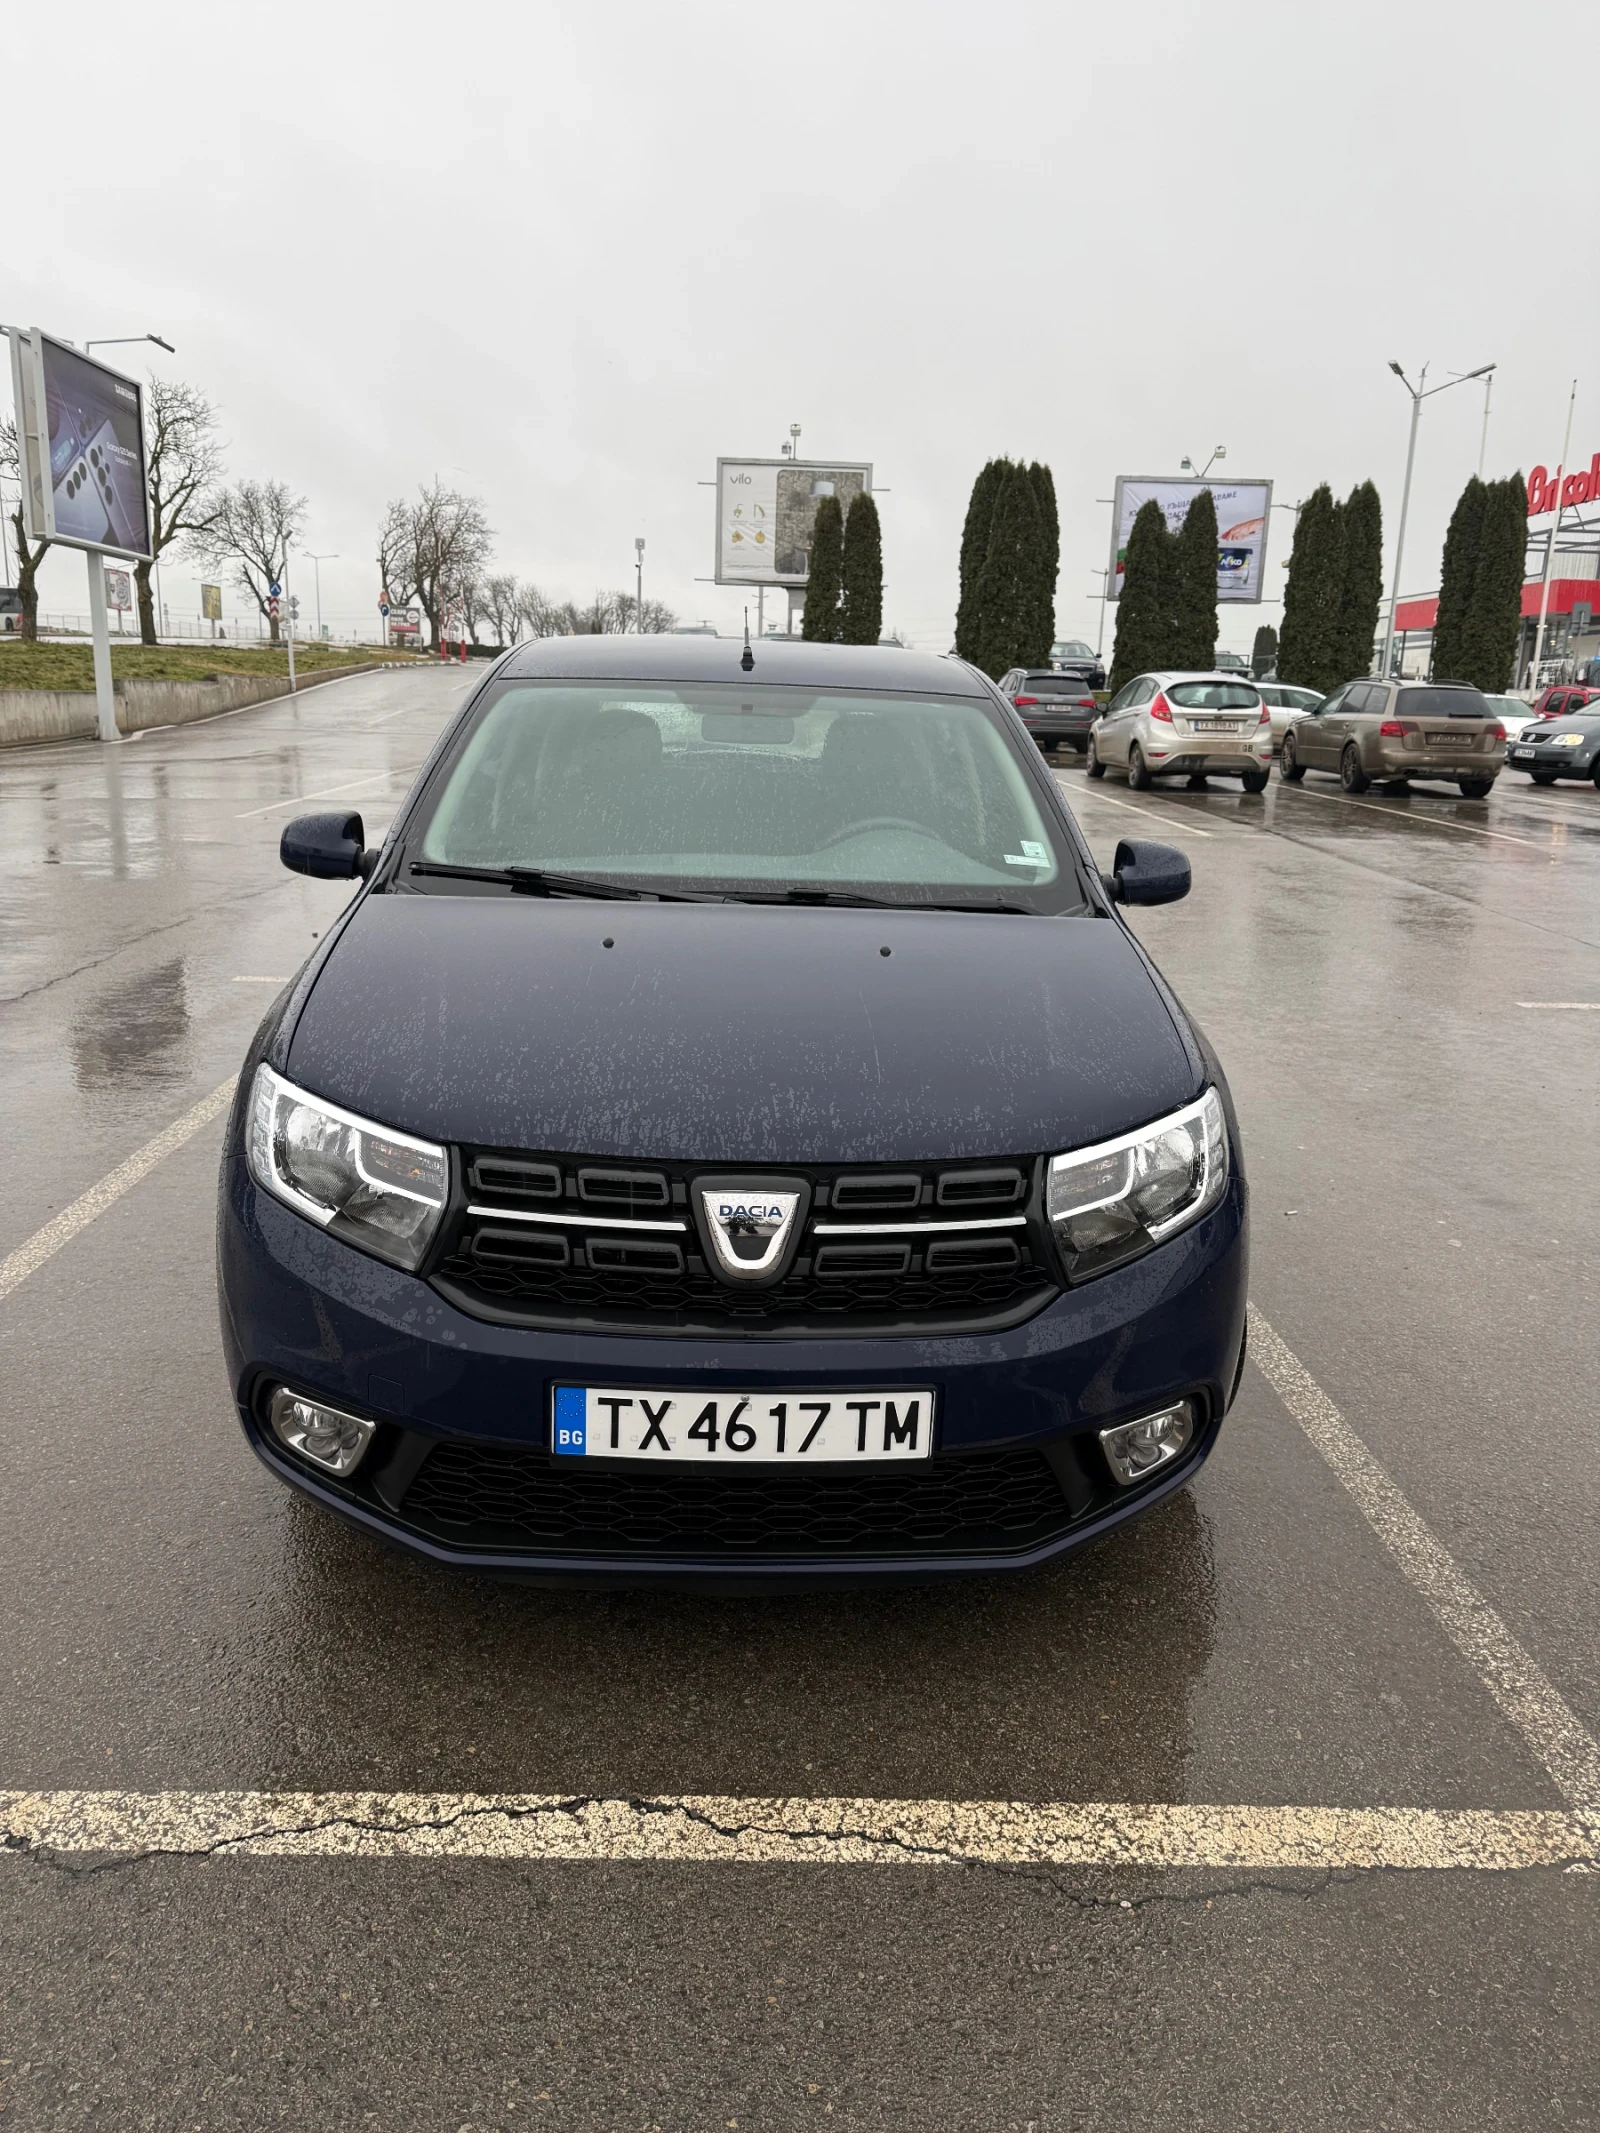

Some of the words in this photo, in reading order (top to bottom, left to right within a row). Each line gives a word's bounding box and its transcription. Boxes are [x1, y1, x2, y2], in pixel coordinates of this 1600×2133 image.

[730, 472, 752, 485] vilo
[1527, 452, 1600, 516] Bricol
[1242, 744, 1254, 753] GB
[719, 1205, 783, 1218] DACIA
[597, 1397, 672, 1451] TX
[687, 1401, 831, 1453] 4617
[846, 1400, 920, 1452] TM
[559, 1430, 583, 1445] BG
